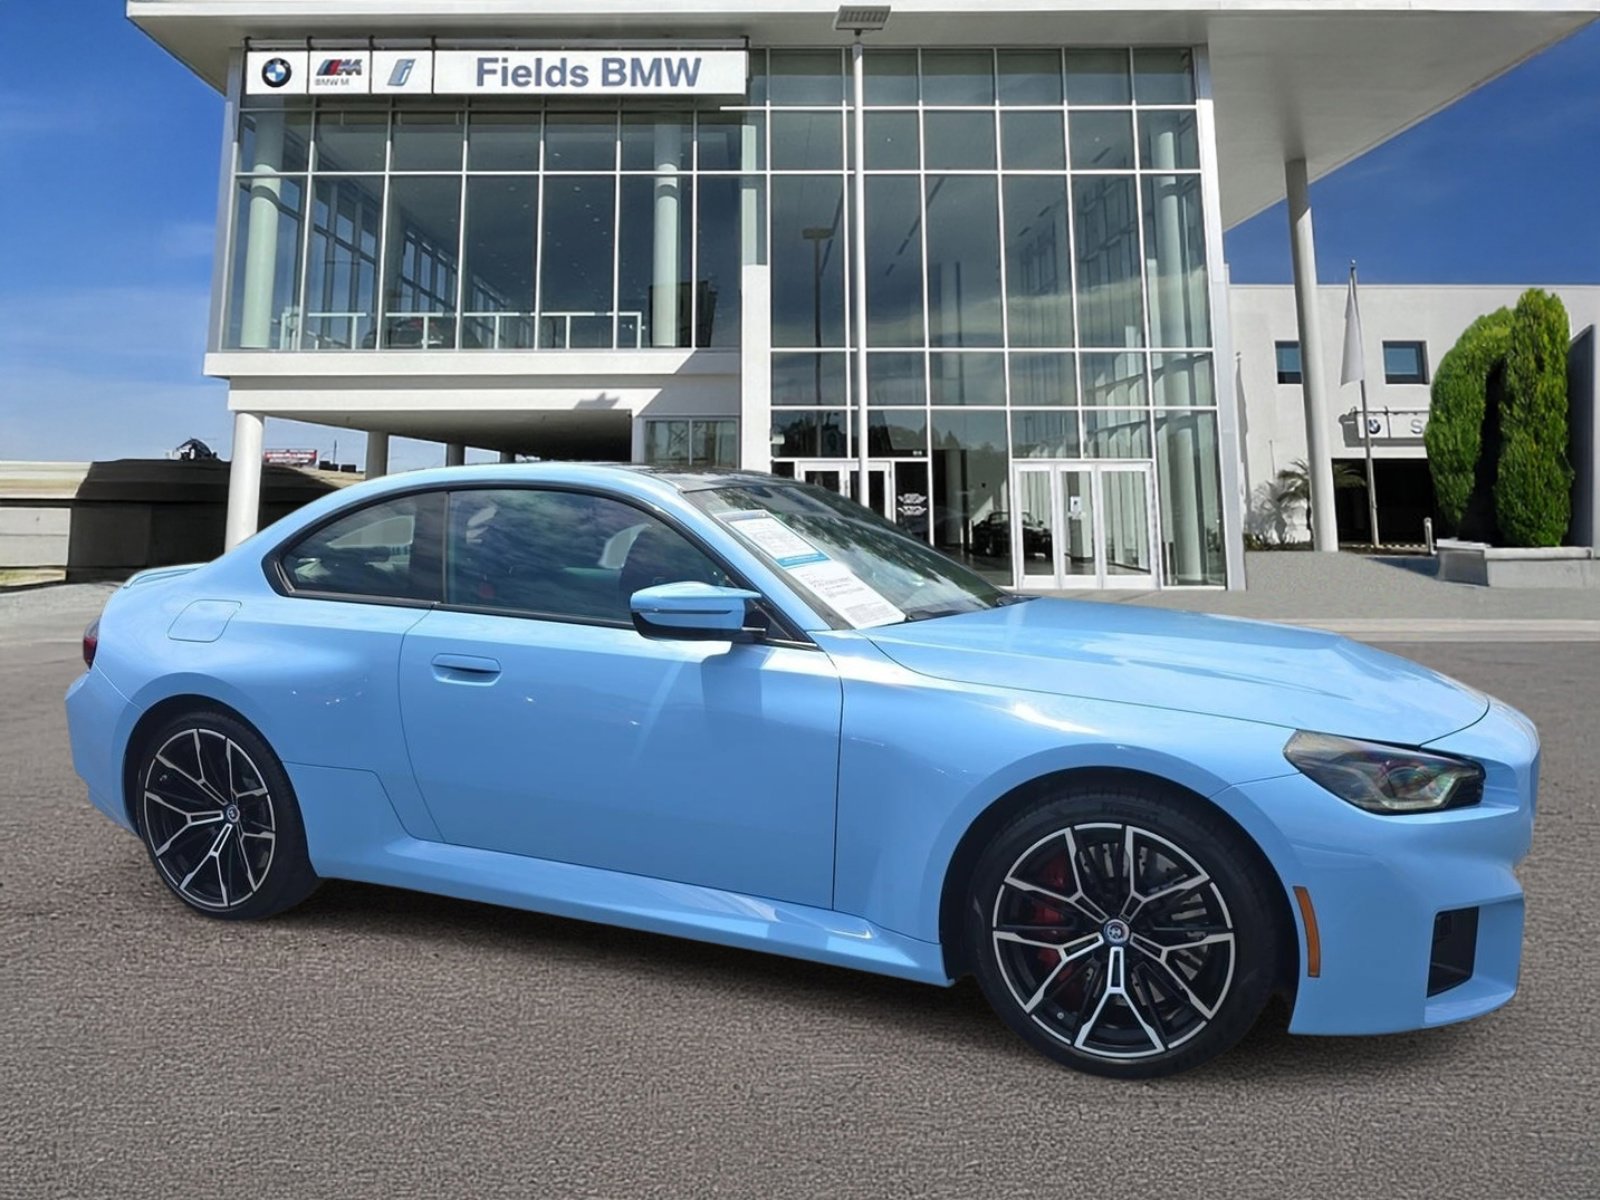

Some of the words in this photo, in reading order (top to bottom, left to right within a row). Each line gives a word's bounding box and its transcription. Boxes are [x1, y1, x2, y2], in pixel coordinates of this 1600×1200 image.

[315, 78, 339, 86] BMW
[340, 78, 350, 86] M
[476, 57, 590, 88] Fields
[601, 57, 702, 87] BMW
